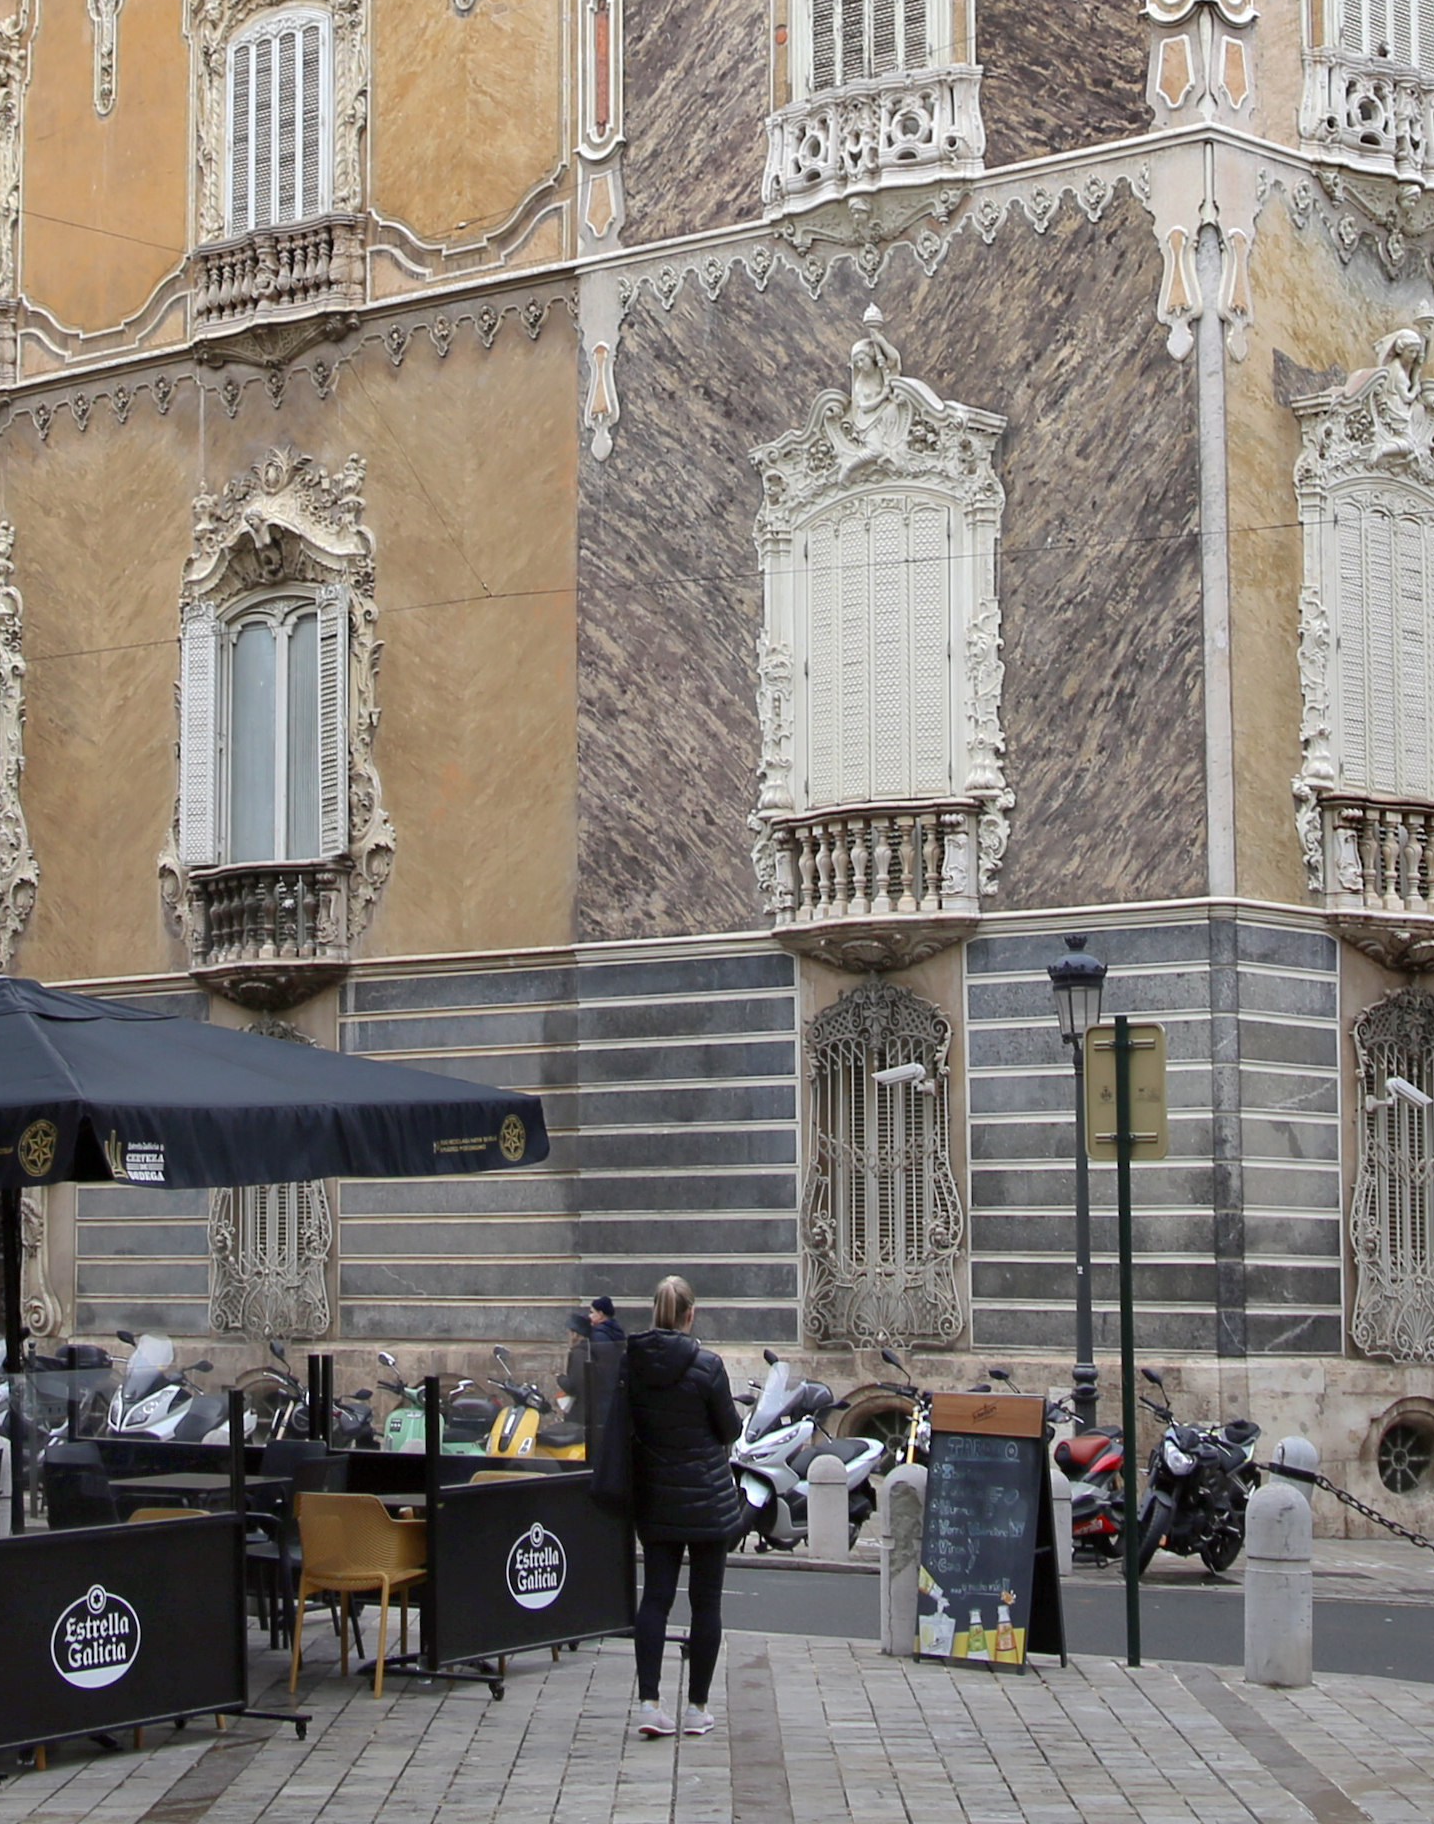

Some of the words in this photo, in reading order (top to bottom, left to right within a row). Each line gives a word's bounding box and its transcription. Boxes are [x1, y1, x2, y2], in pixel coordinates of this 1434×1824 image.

[515, 1546, 559, 1570] Estrella
[517, 1566, 558, 1592] Galicia
[64, 1611, 130, 1643] Estrella
[68, 1636, 127, 1668] Galicia
